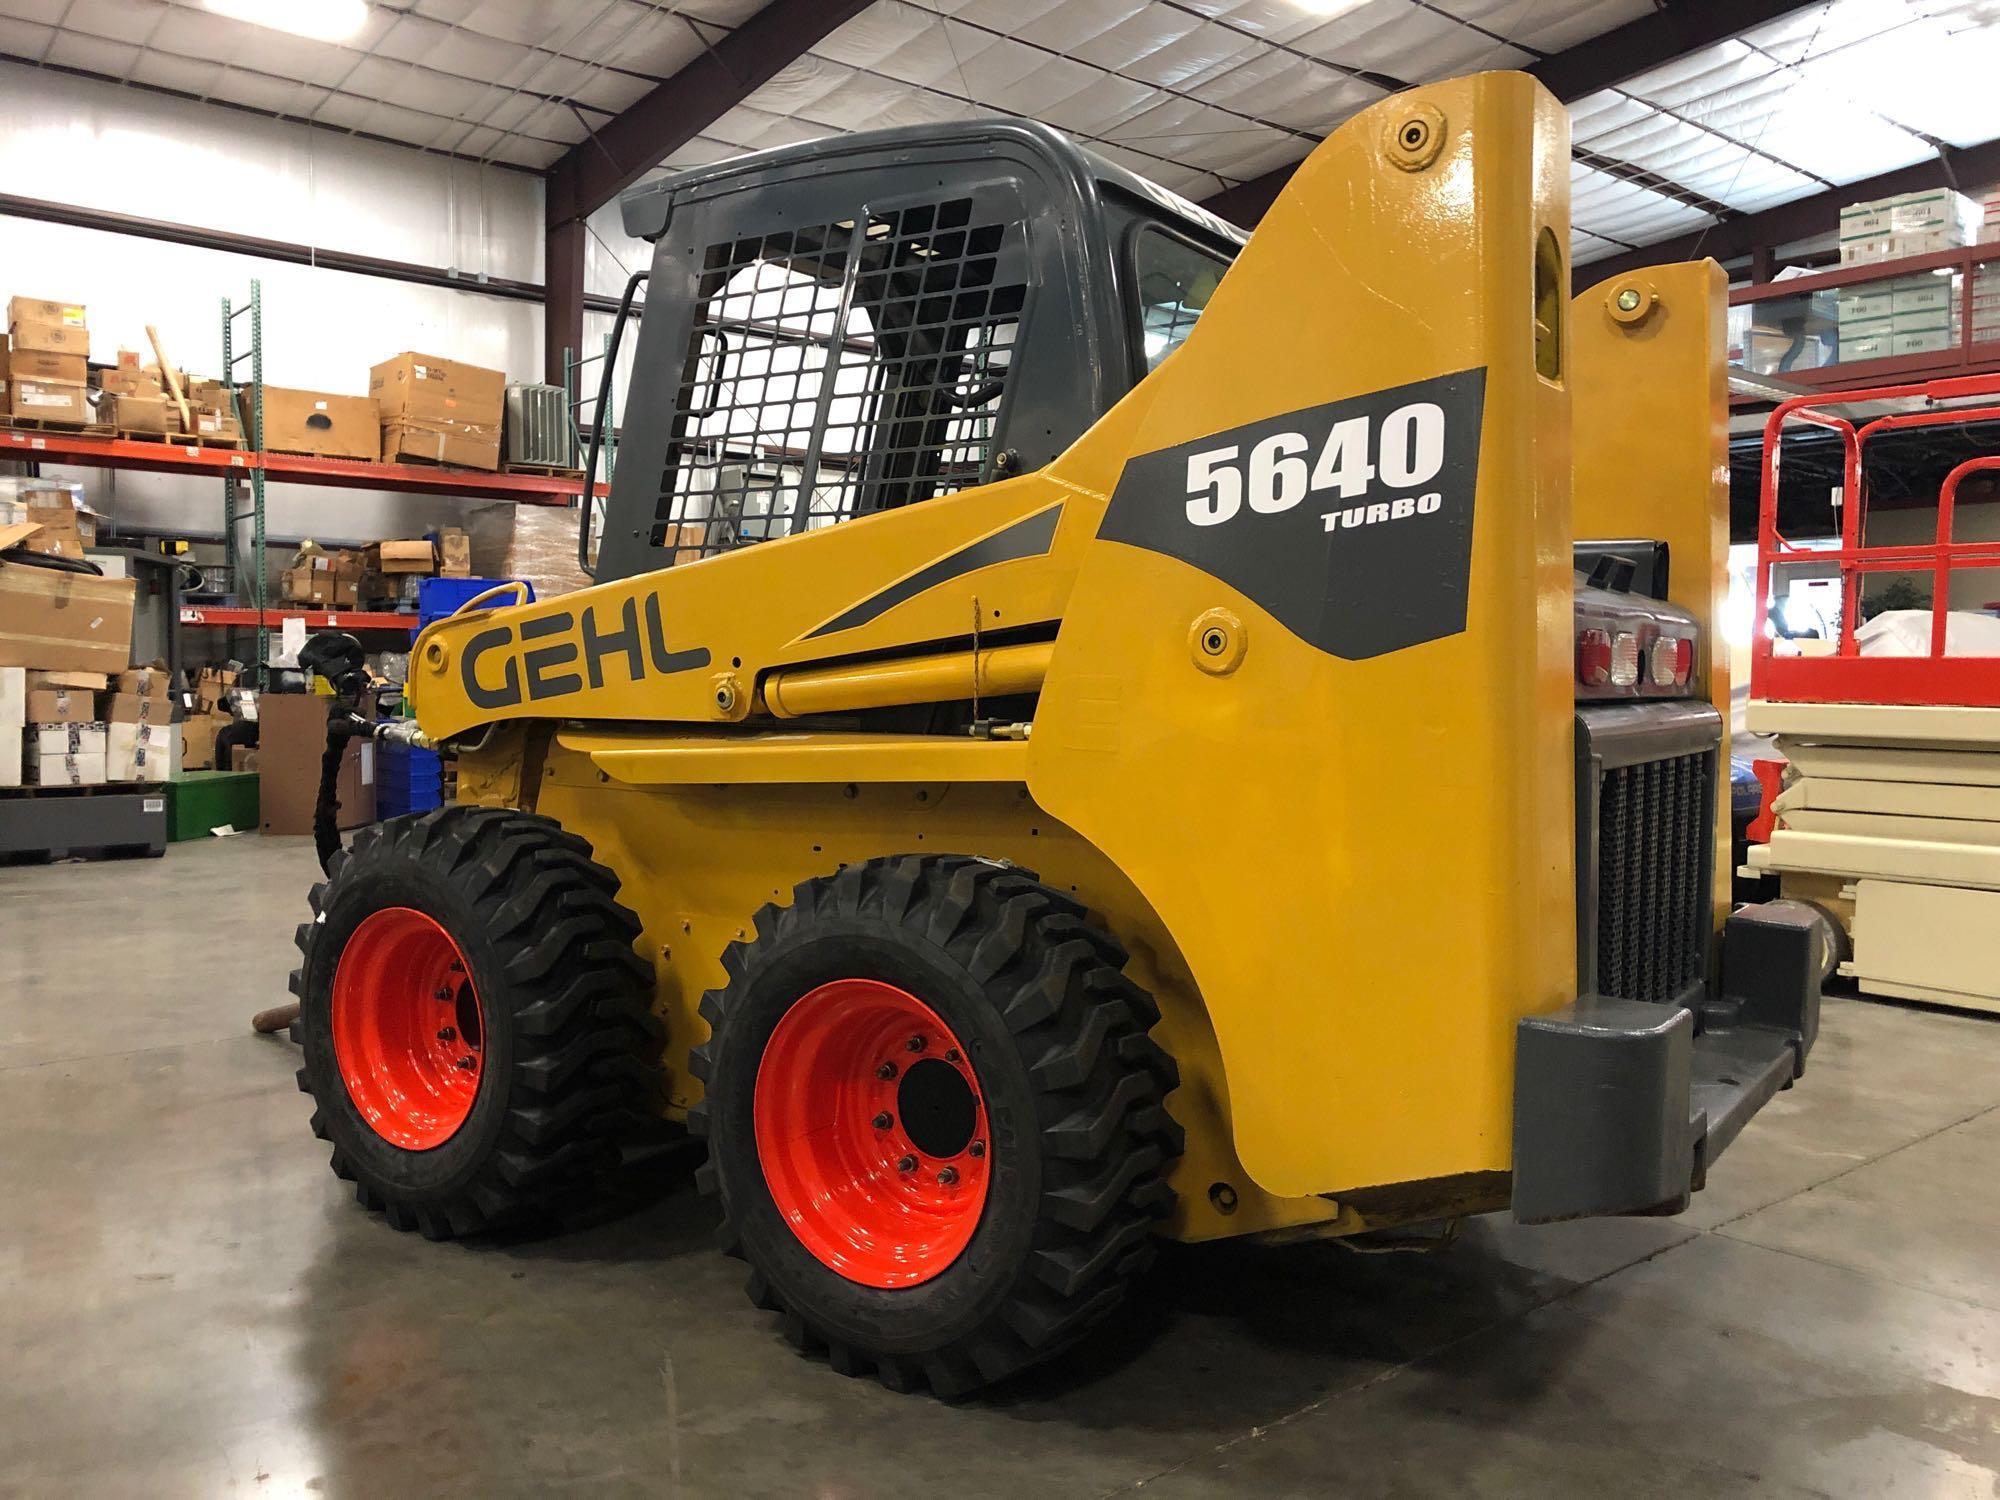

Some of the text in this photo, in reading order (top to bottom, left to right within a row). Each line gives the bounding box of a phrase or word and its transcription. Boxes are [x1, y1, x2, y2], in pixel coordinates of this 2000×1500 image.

[1185, 402, 1445, 527] 5640
[1320, 493, 1442, 532] TURBO
[461, 591, 711, 710] GEHL
